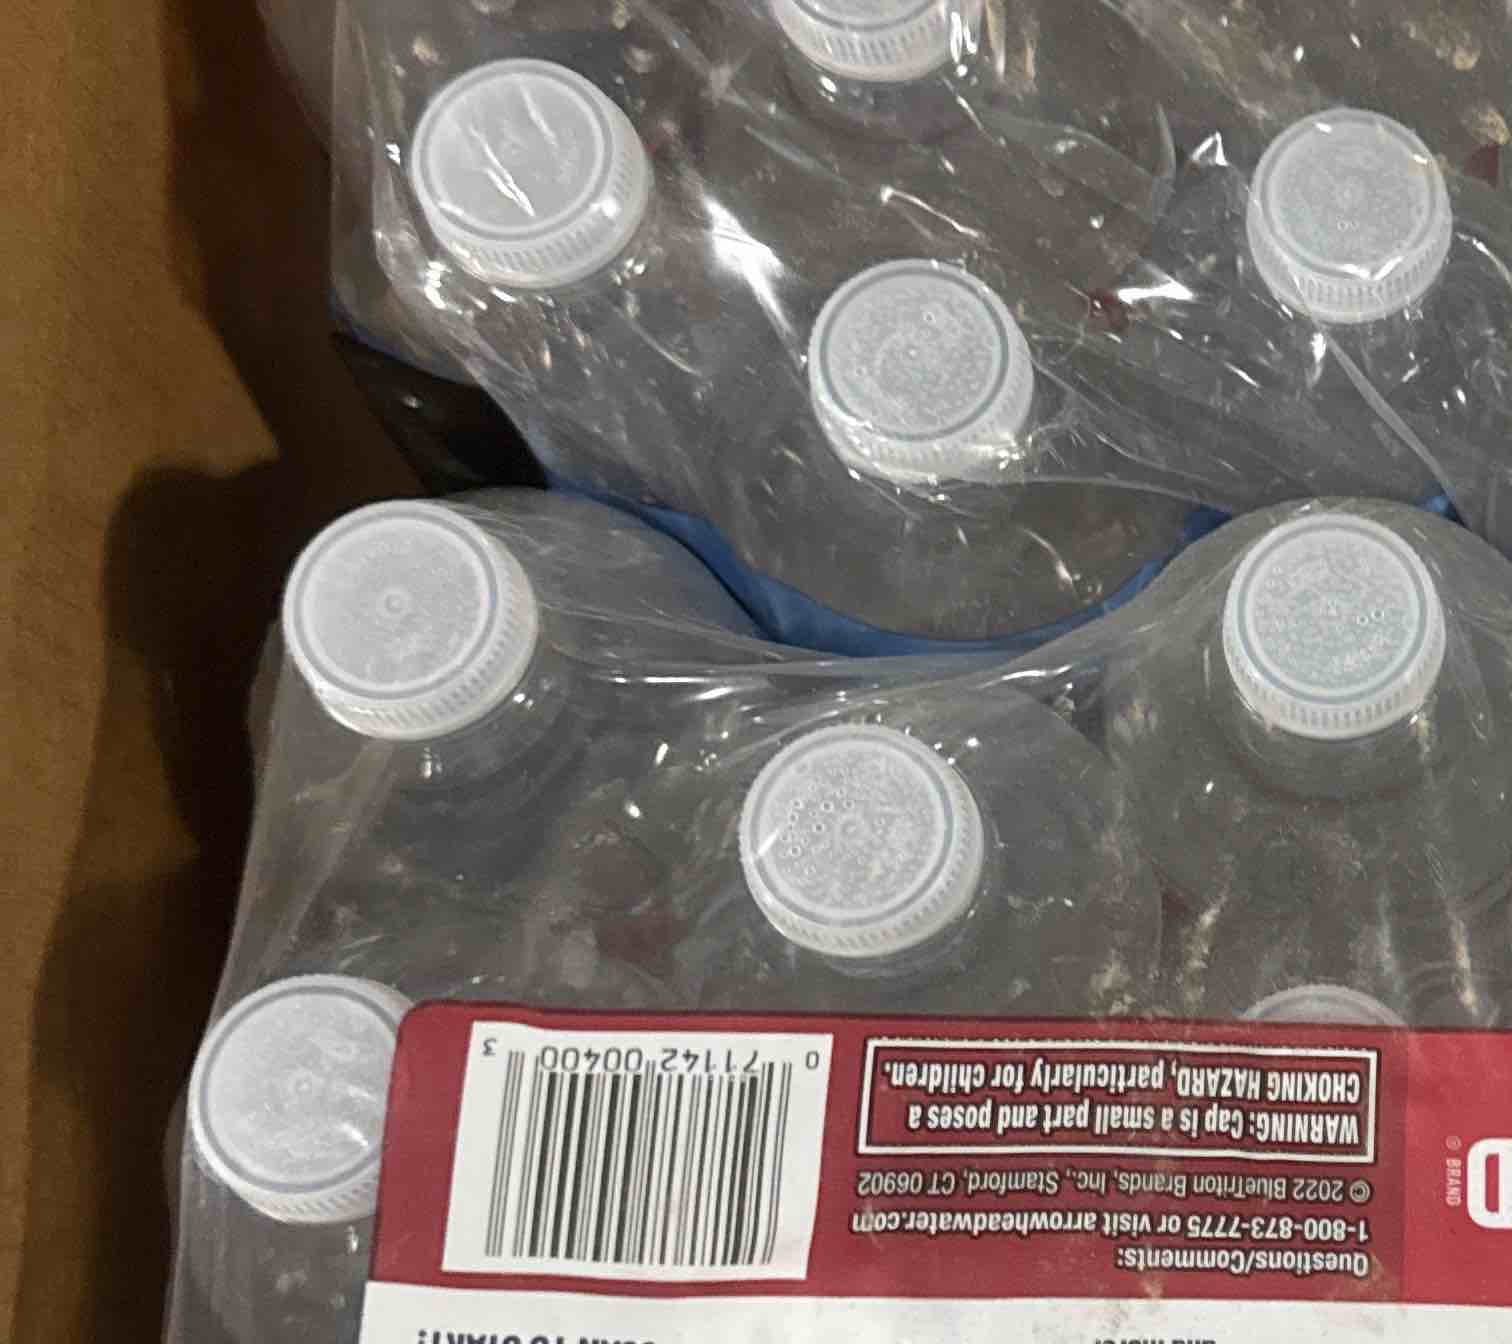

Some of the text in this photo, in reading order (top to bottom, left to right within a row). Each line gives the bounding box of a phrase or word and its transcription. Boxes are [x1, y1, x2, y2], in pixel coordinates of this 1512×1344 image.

[482, 1037, 820, 1072] 0 71142 00400 3
[883, 1056, 1361, 1103] CHOKING HAZARD, particularly for children.
[909, 1097, 1360, 1145] WARNING: Cap is a small part and poses a
[857, 1170, 924, 1193] 06902
[928, 1171, 956, 1194] CT
[963, 1168, 1059, 1193] Stamford,
[1064, 1170, 1107, 1196] Inc.,
[1112, 1170, 1188, 1197] Brands,
[1192, 1175, 1287, 1199] BlueTriton
[1292, 1178, 1345, 1200] 2022
[1446, 1158, 1461, 1206] BRAND
[851, 1211, 1369, 1241] 1-800-873-7775 or visit arrowheadwater.com
[1115, 1247, 1369, 1275] Questions/Comments:
